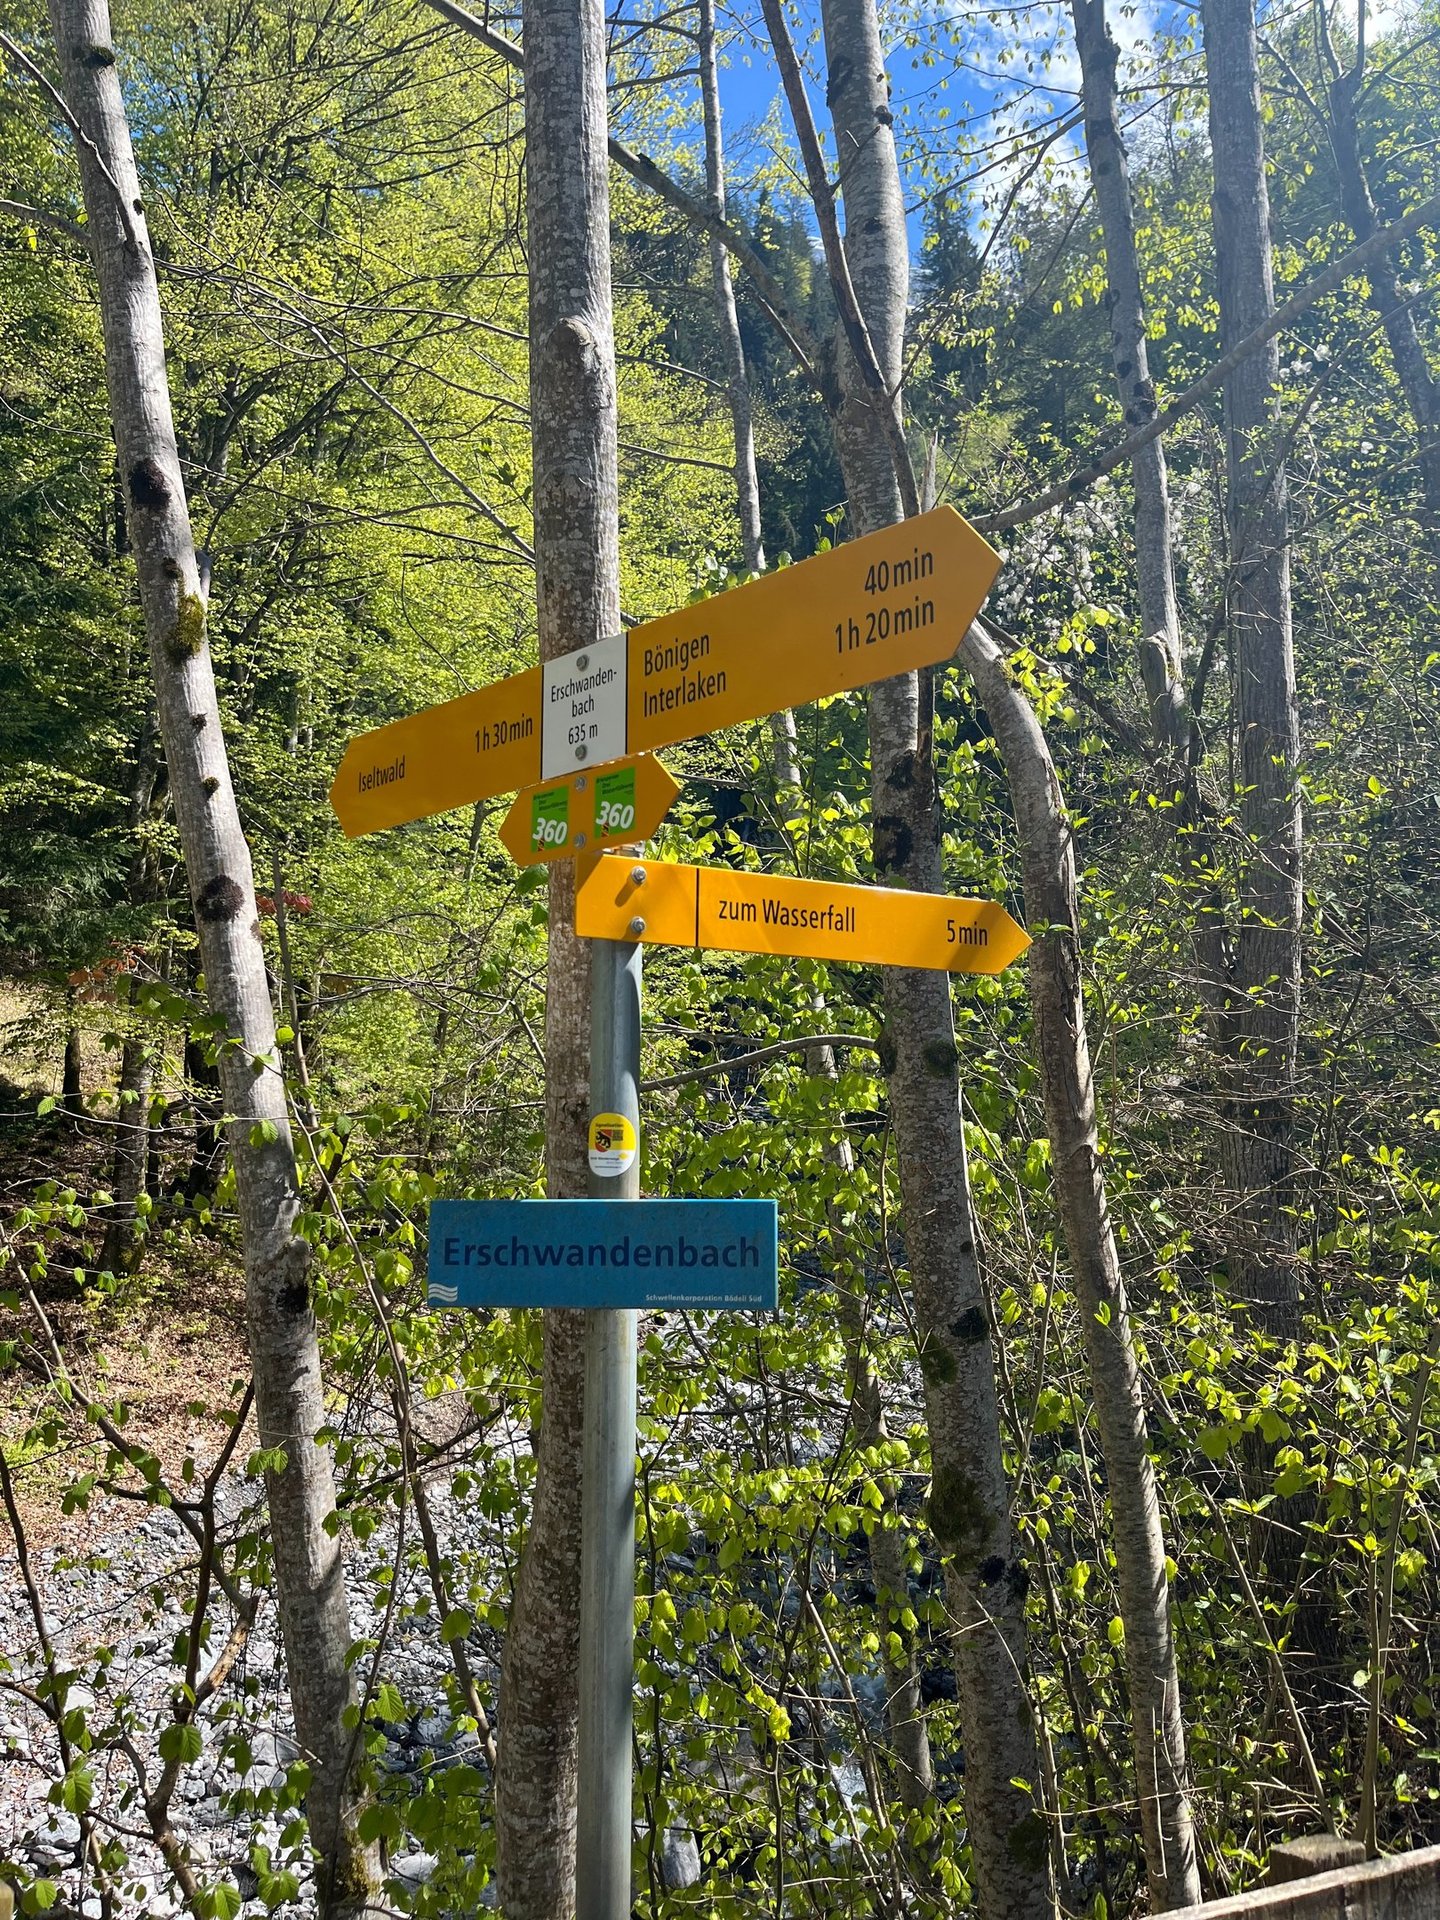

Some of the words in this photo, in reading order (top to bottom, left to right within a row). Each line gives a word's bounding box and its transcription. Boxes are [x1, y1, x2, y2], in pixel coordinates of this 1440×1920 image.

[644, 634, 710, 677] Bönigen
[551, 667, 617, 703] Erschwanden-
[644, 670, 726, 717] Interlaken
[571, 693, 595, 718] bach
[568, 723, 586, 745] 635
[589, 723, 598, 739] m
[358, 755, 406, 793] Iseltwald
[532, 817, 568, 845] 360
[595, 801, 635, 829] 360
[719, 900, 757, 922] zum
[762, 898, 855, 933] Wasserfall
[443, 1235, 759, 1268] Erschwandenbach
[645, 1294, 723, 1302] Schwellenkorporation
